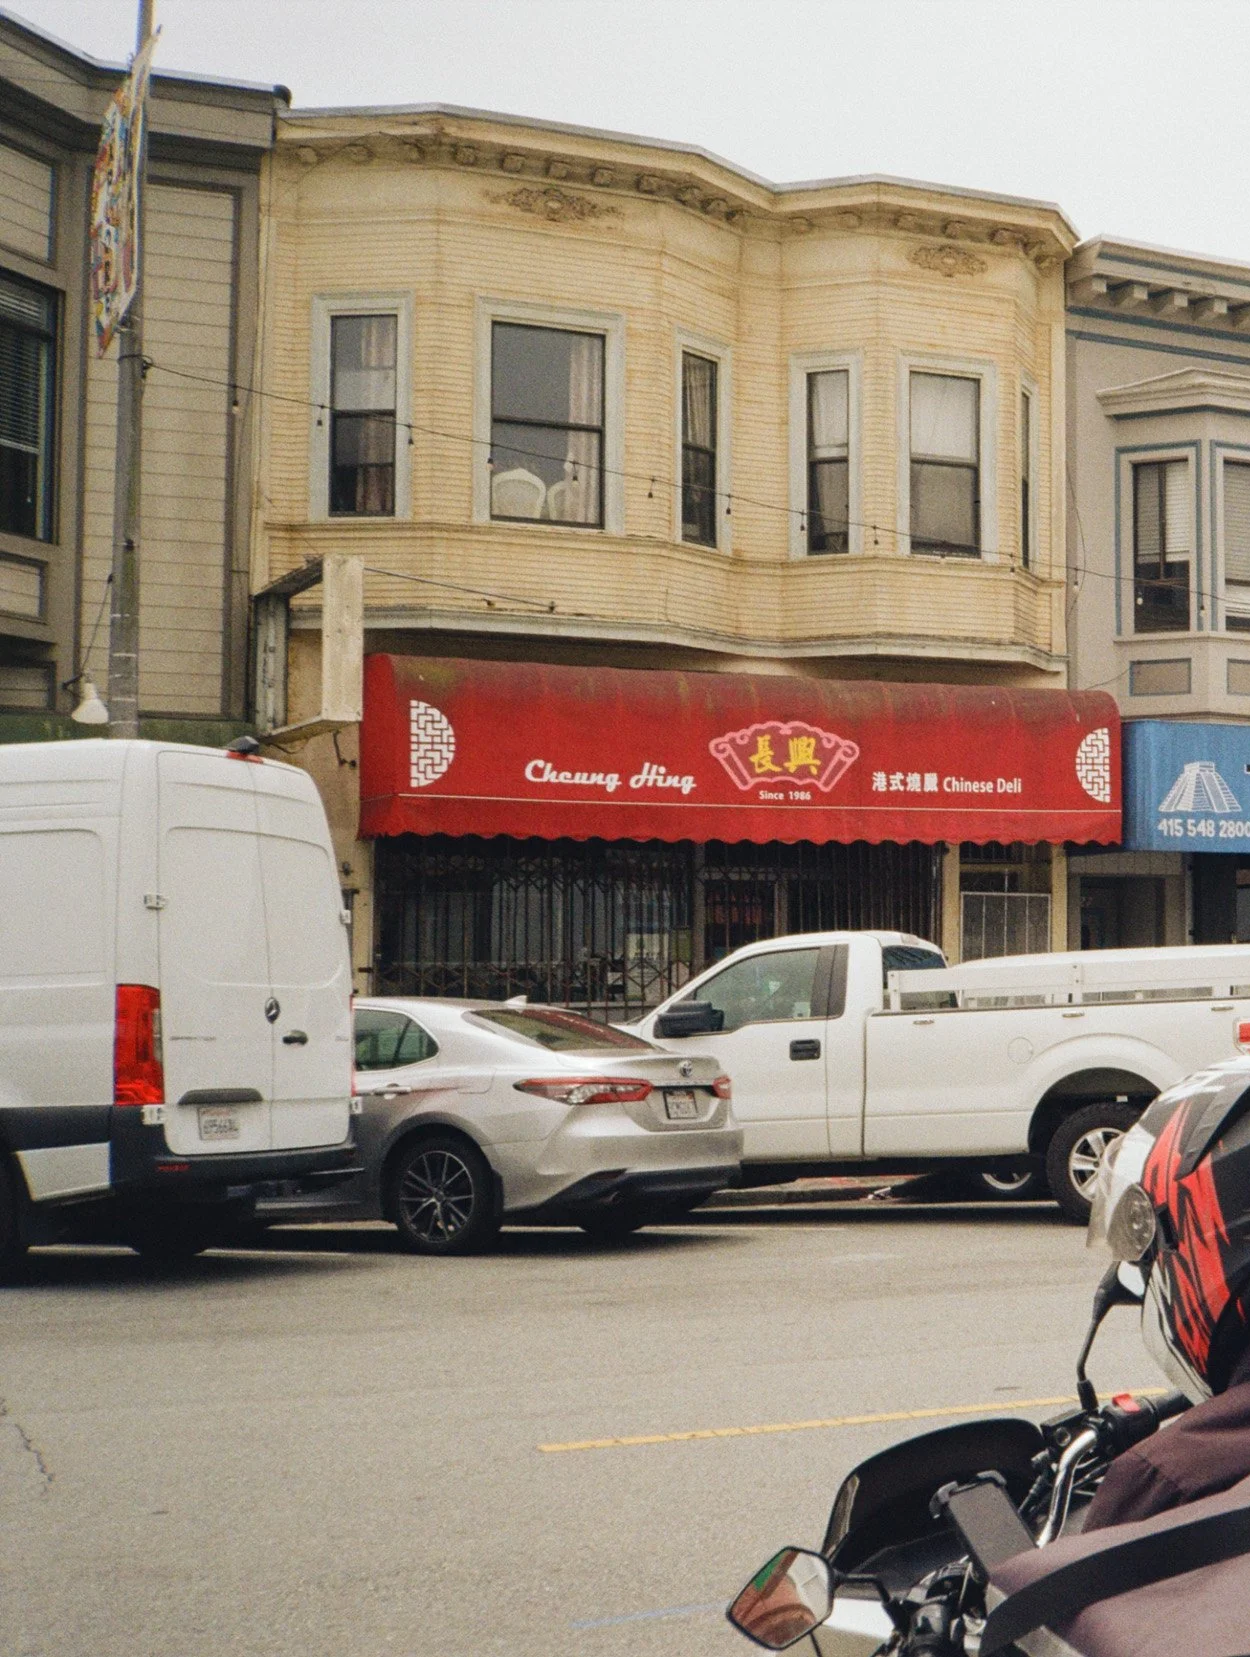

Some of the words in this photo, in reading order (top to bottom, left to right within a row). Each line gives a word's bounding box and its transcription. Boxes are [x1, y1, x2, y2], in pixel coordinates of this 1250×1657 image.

[525, 759, 622, 792] Cheung
[629, 762, 697, 794] Hing
[943, 776, 993, 793] Chinese
[997, 778, 1022, 793] Deli
[759, 790, 784, 800] Since
[789, 791, 811, 800] 1986
[1158, 818, 1183, 836] 415
[1187, 818, 1215, 837] 548
